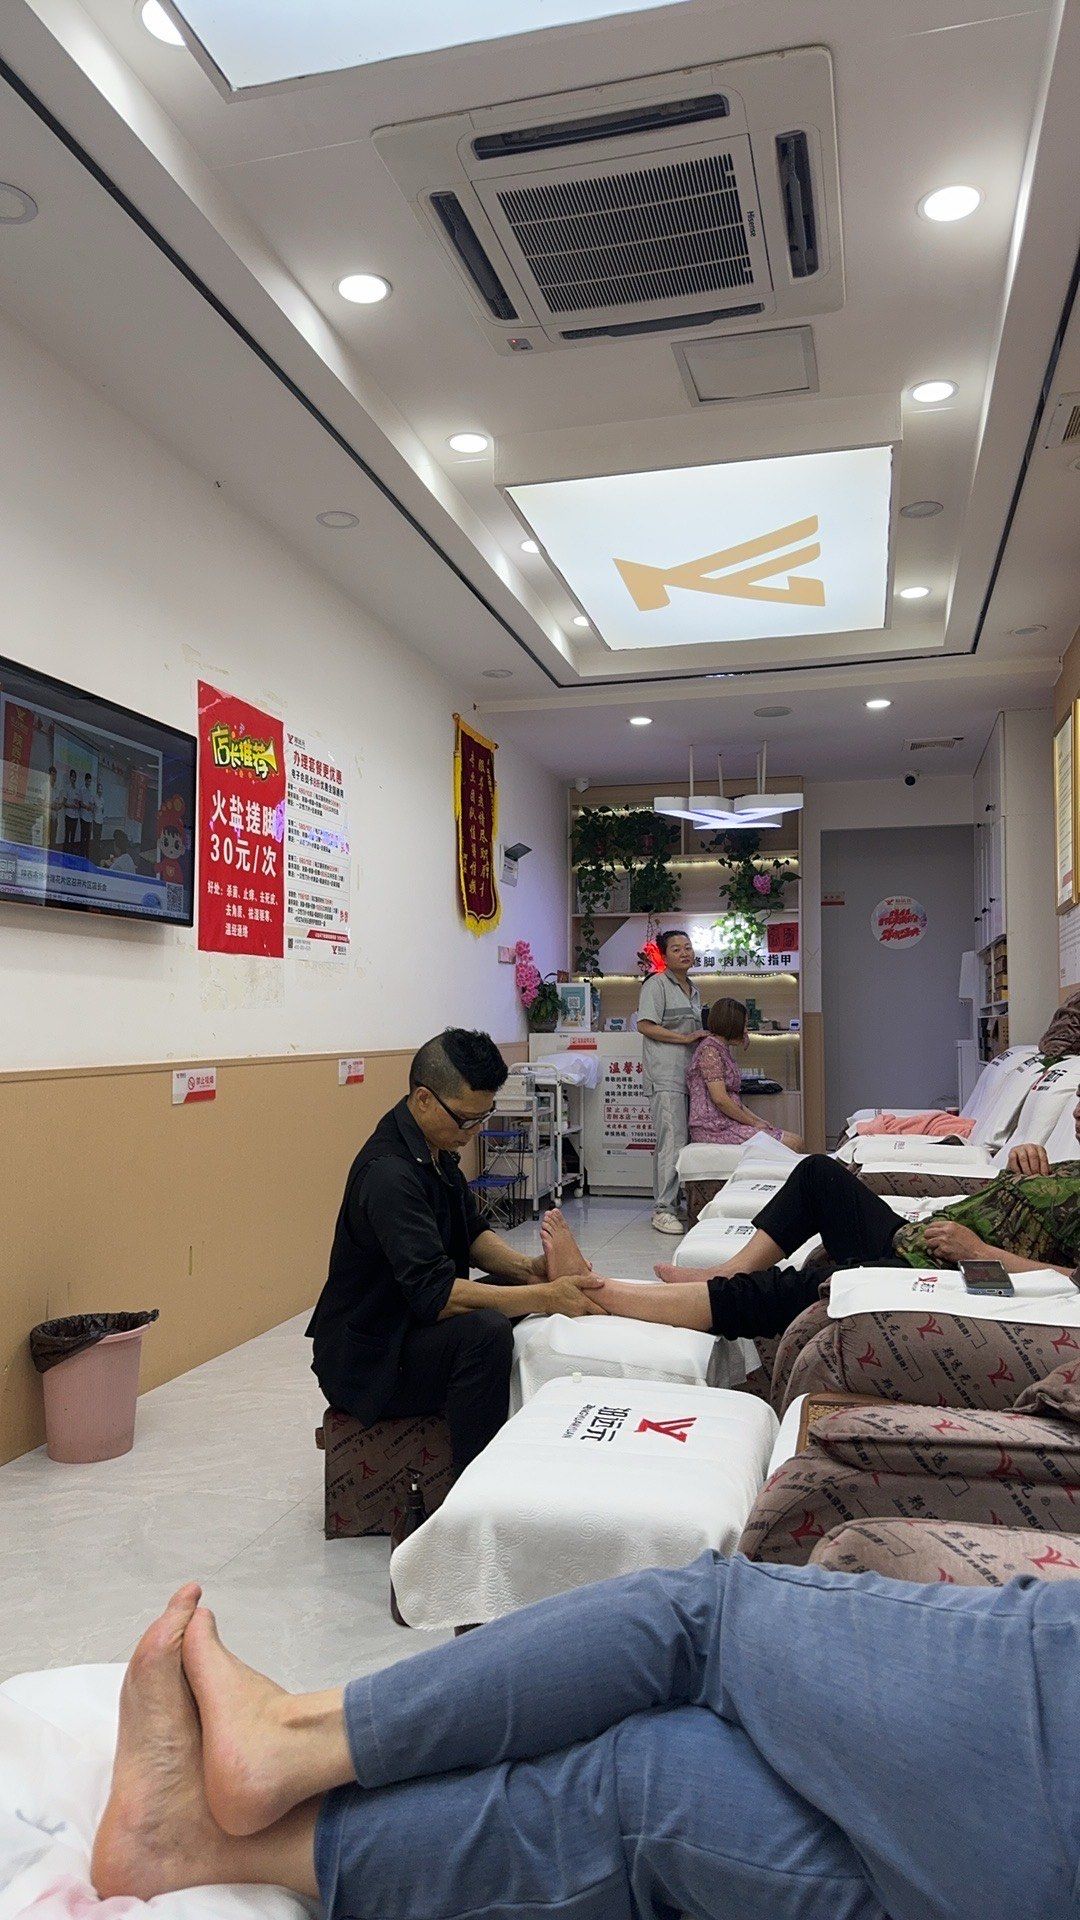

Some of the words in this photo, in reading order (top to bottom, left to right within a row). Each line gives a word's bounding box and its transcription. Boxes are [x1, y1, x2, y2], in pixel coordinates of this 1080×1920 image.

[747, 211, 756, 237] Hisense
[293, 750, 342, 785] 办理套餐更优惠
[211, 789, 277, 839] 火盐搓脚
[210, 833, 277, 878] 30元/次
